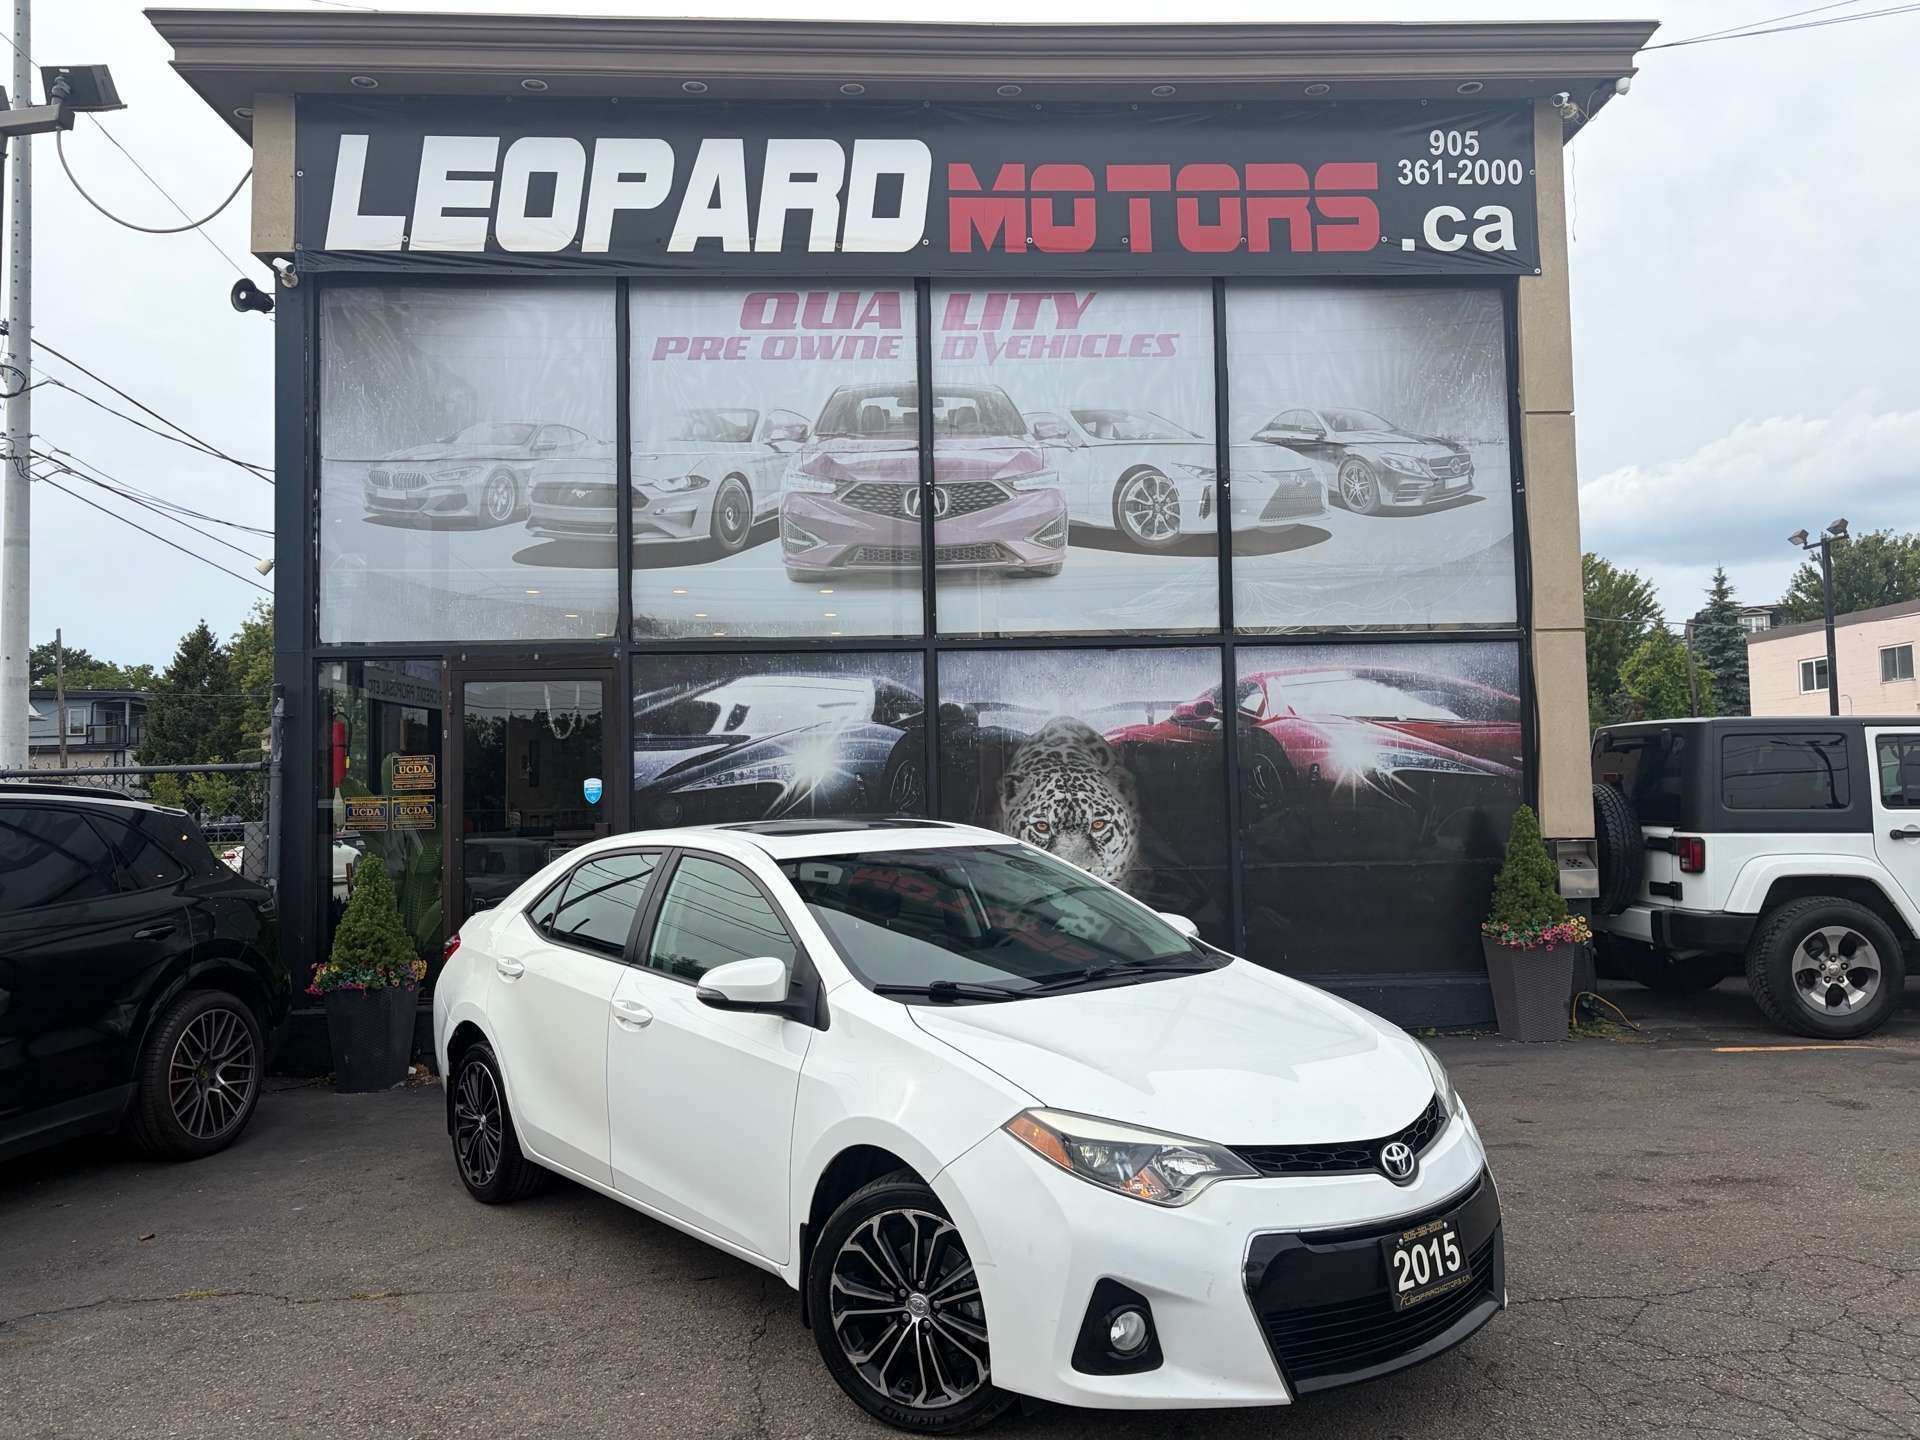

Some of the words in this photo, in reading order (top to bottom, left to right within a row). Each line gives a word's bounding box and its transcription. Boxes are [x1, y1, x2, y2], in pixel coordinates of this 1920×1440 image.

[1429, 130, 1480, 156] 905
[1398, 159, 1523, 185] 361-2000
[325, 134, 932, 253] LEOPARD
[949, 162, 1380, 253] MOTORS
[1401, 205, 1517, 252] .ca
[652, 336, 751, 360] PRE
[399, 765, 429, 774] UCDA
[352, 808, 381, 816] UCDA
[400, 806, 429, 815] UCDA
[1393, 1231, 1460, 1292] 2015
